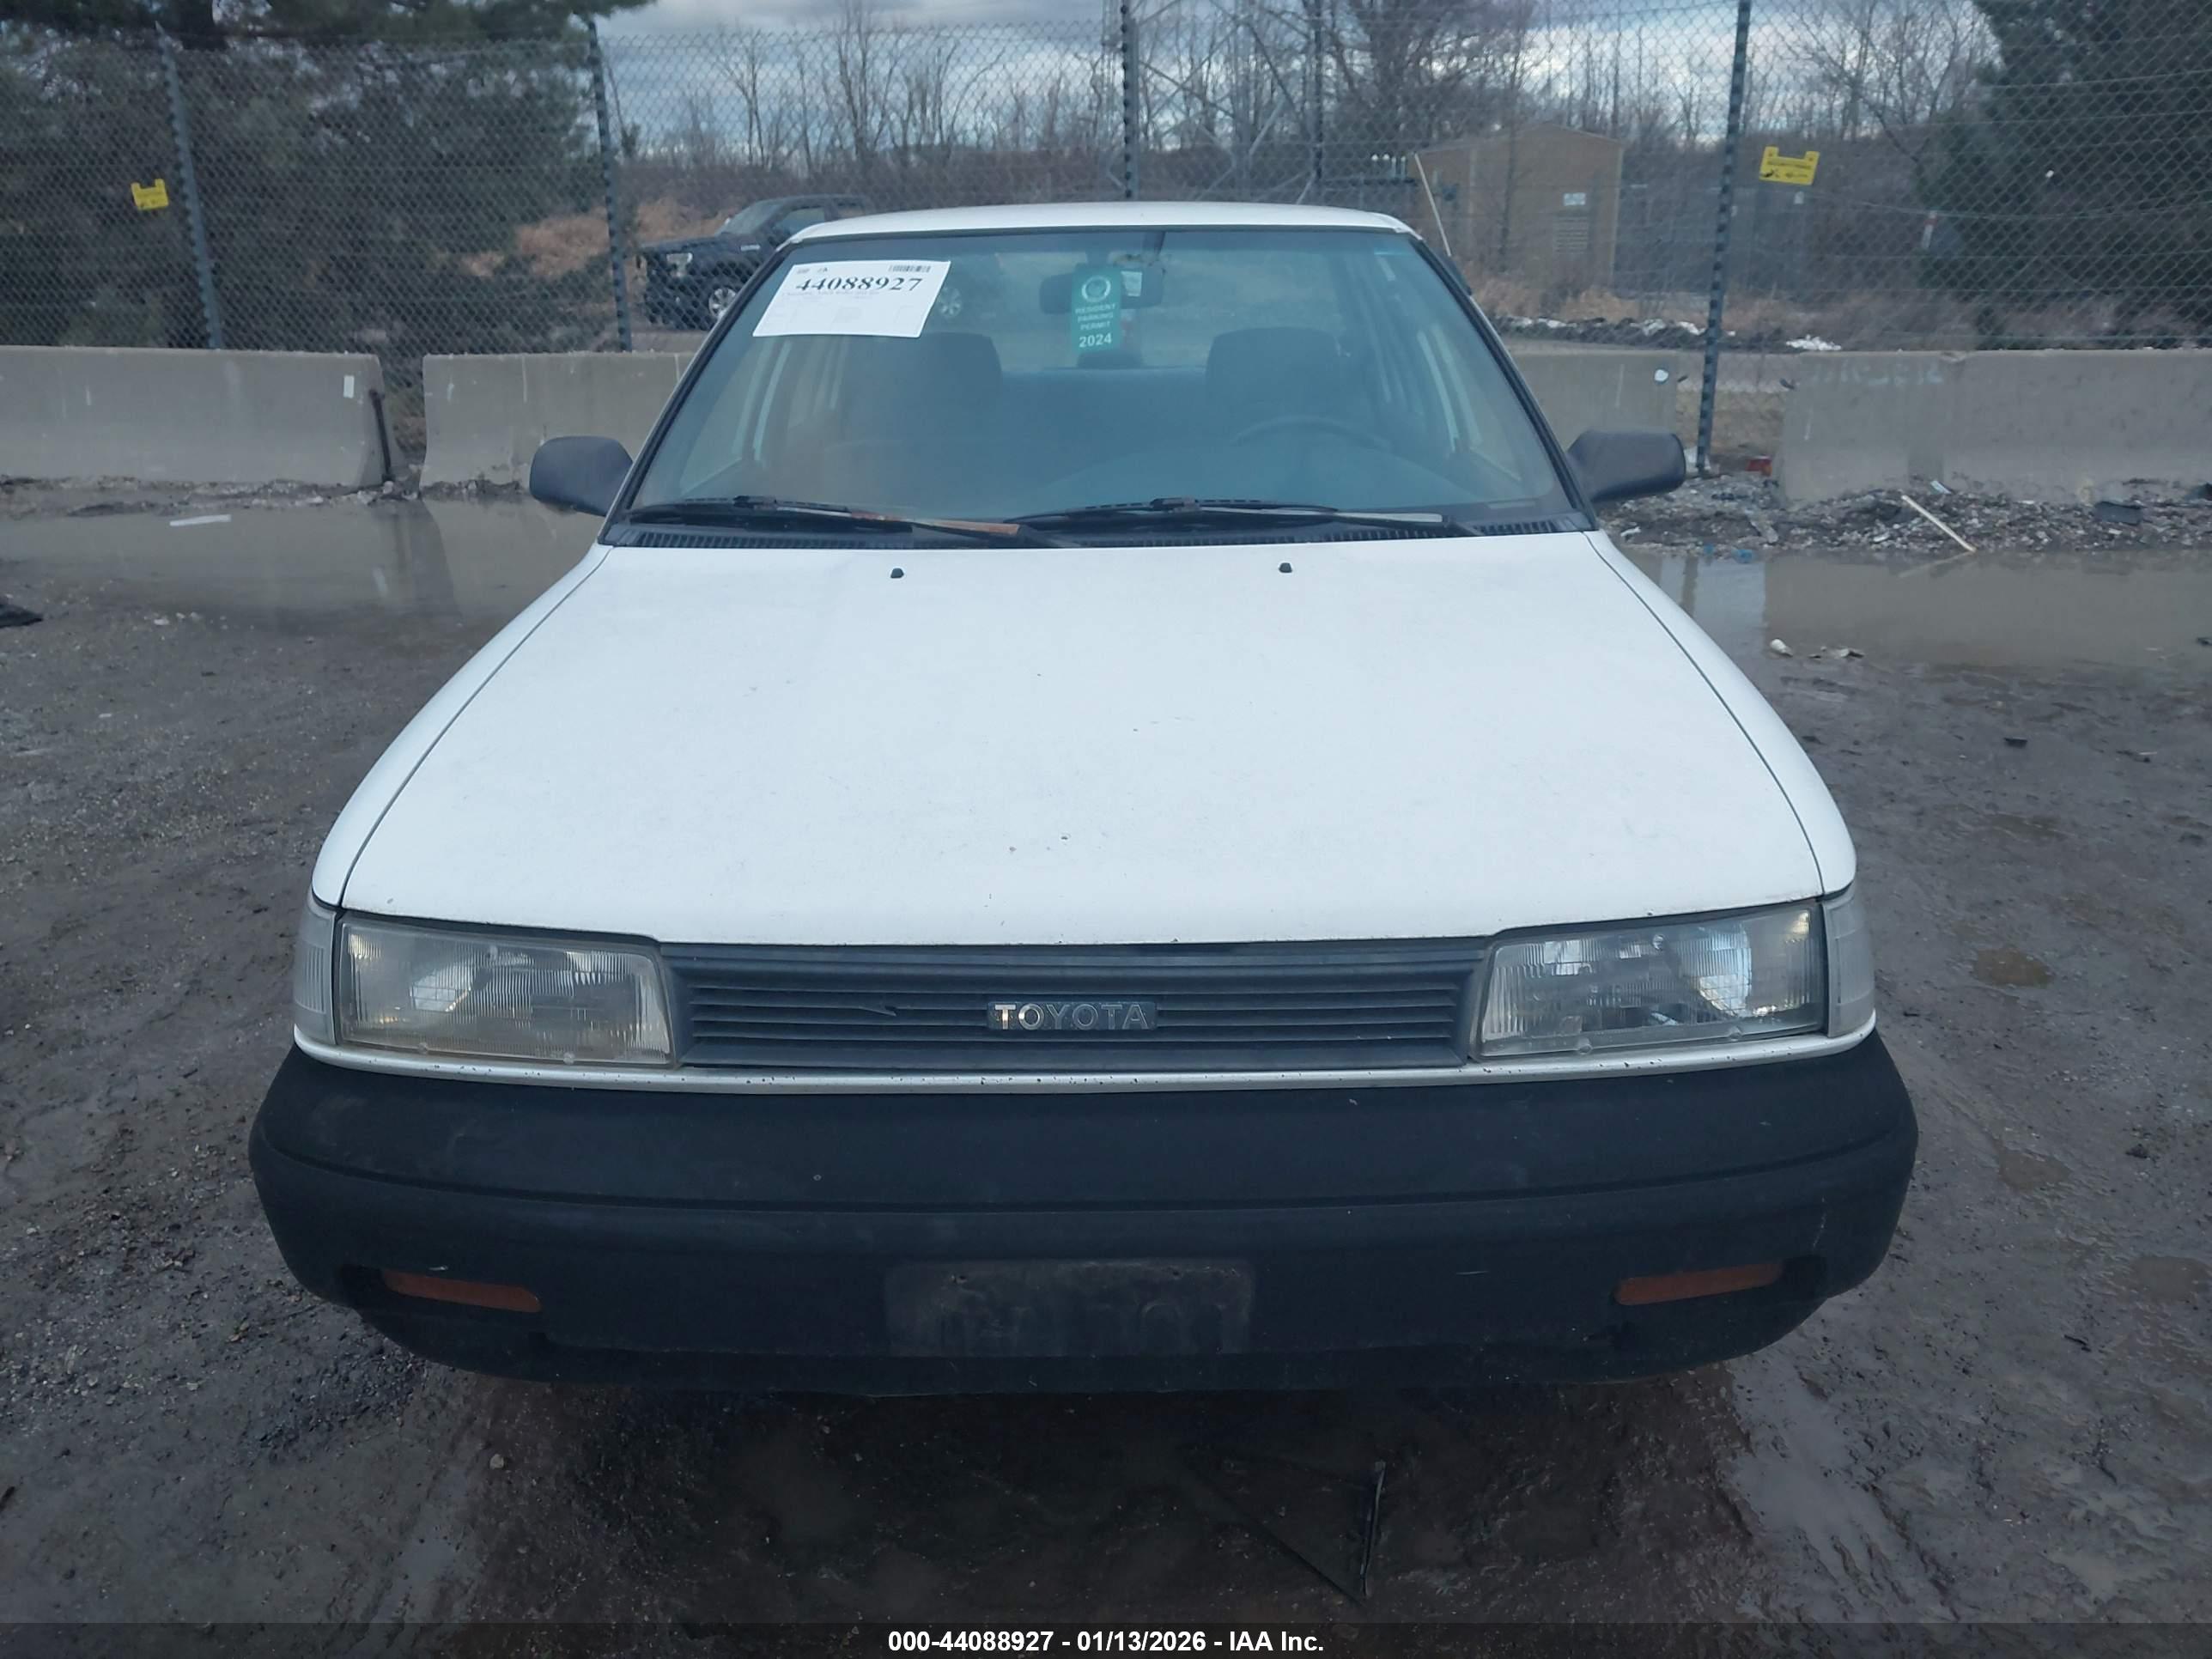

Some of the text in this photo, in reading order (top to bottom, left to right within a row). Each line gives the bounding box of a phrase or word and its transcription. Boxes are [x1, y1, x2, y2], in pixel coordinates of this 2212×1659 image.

[795, 276, 924, 291] 44088927
[1079, 332, 1112, 348] 2024
[994, 1003, 1149, 1030] TOYOTA
